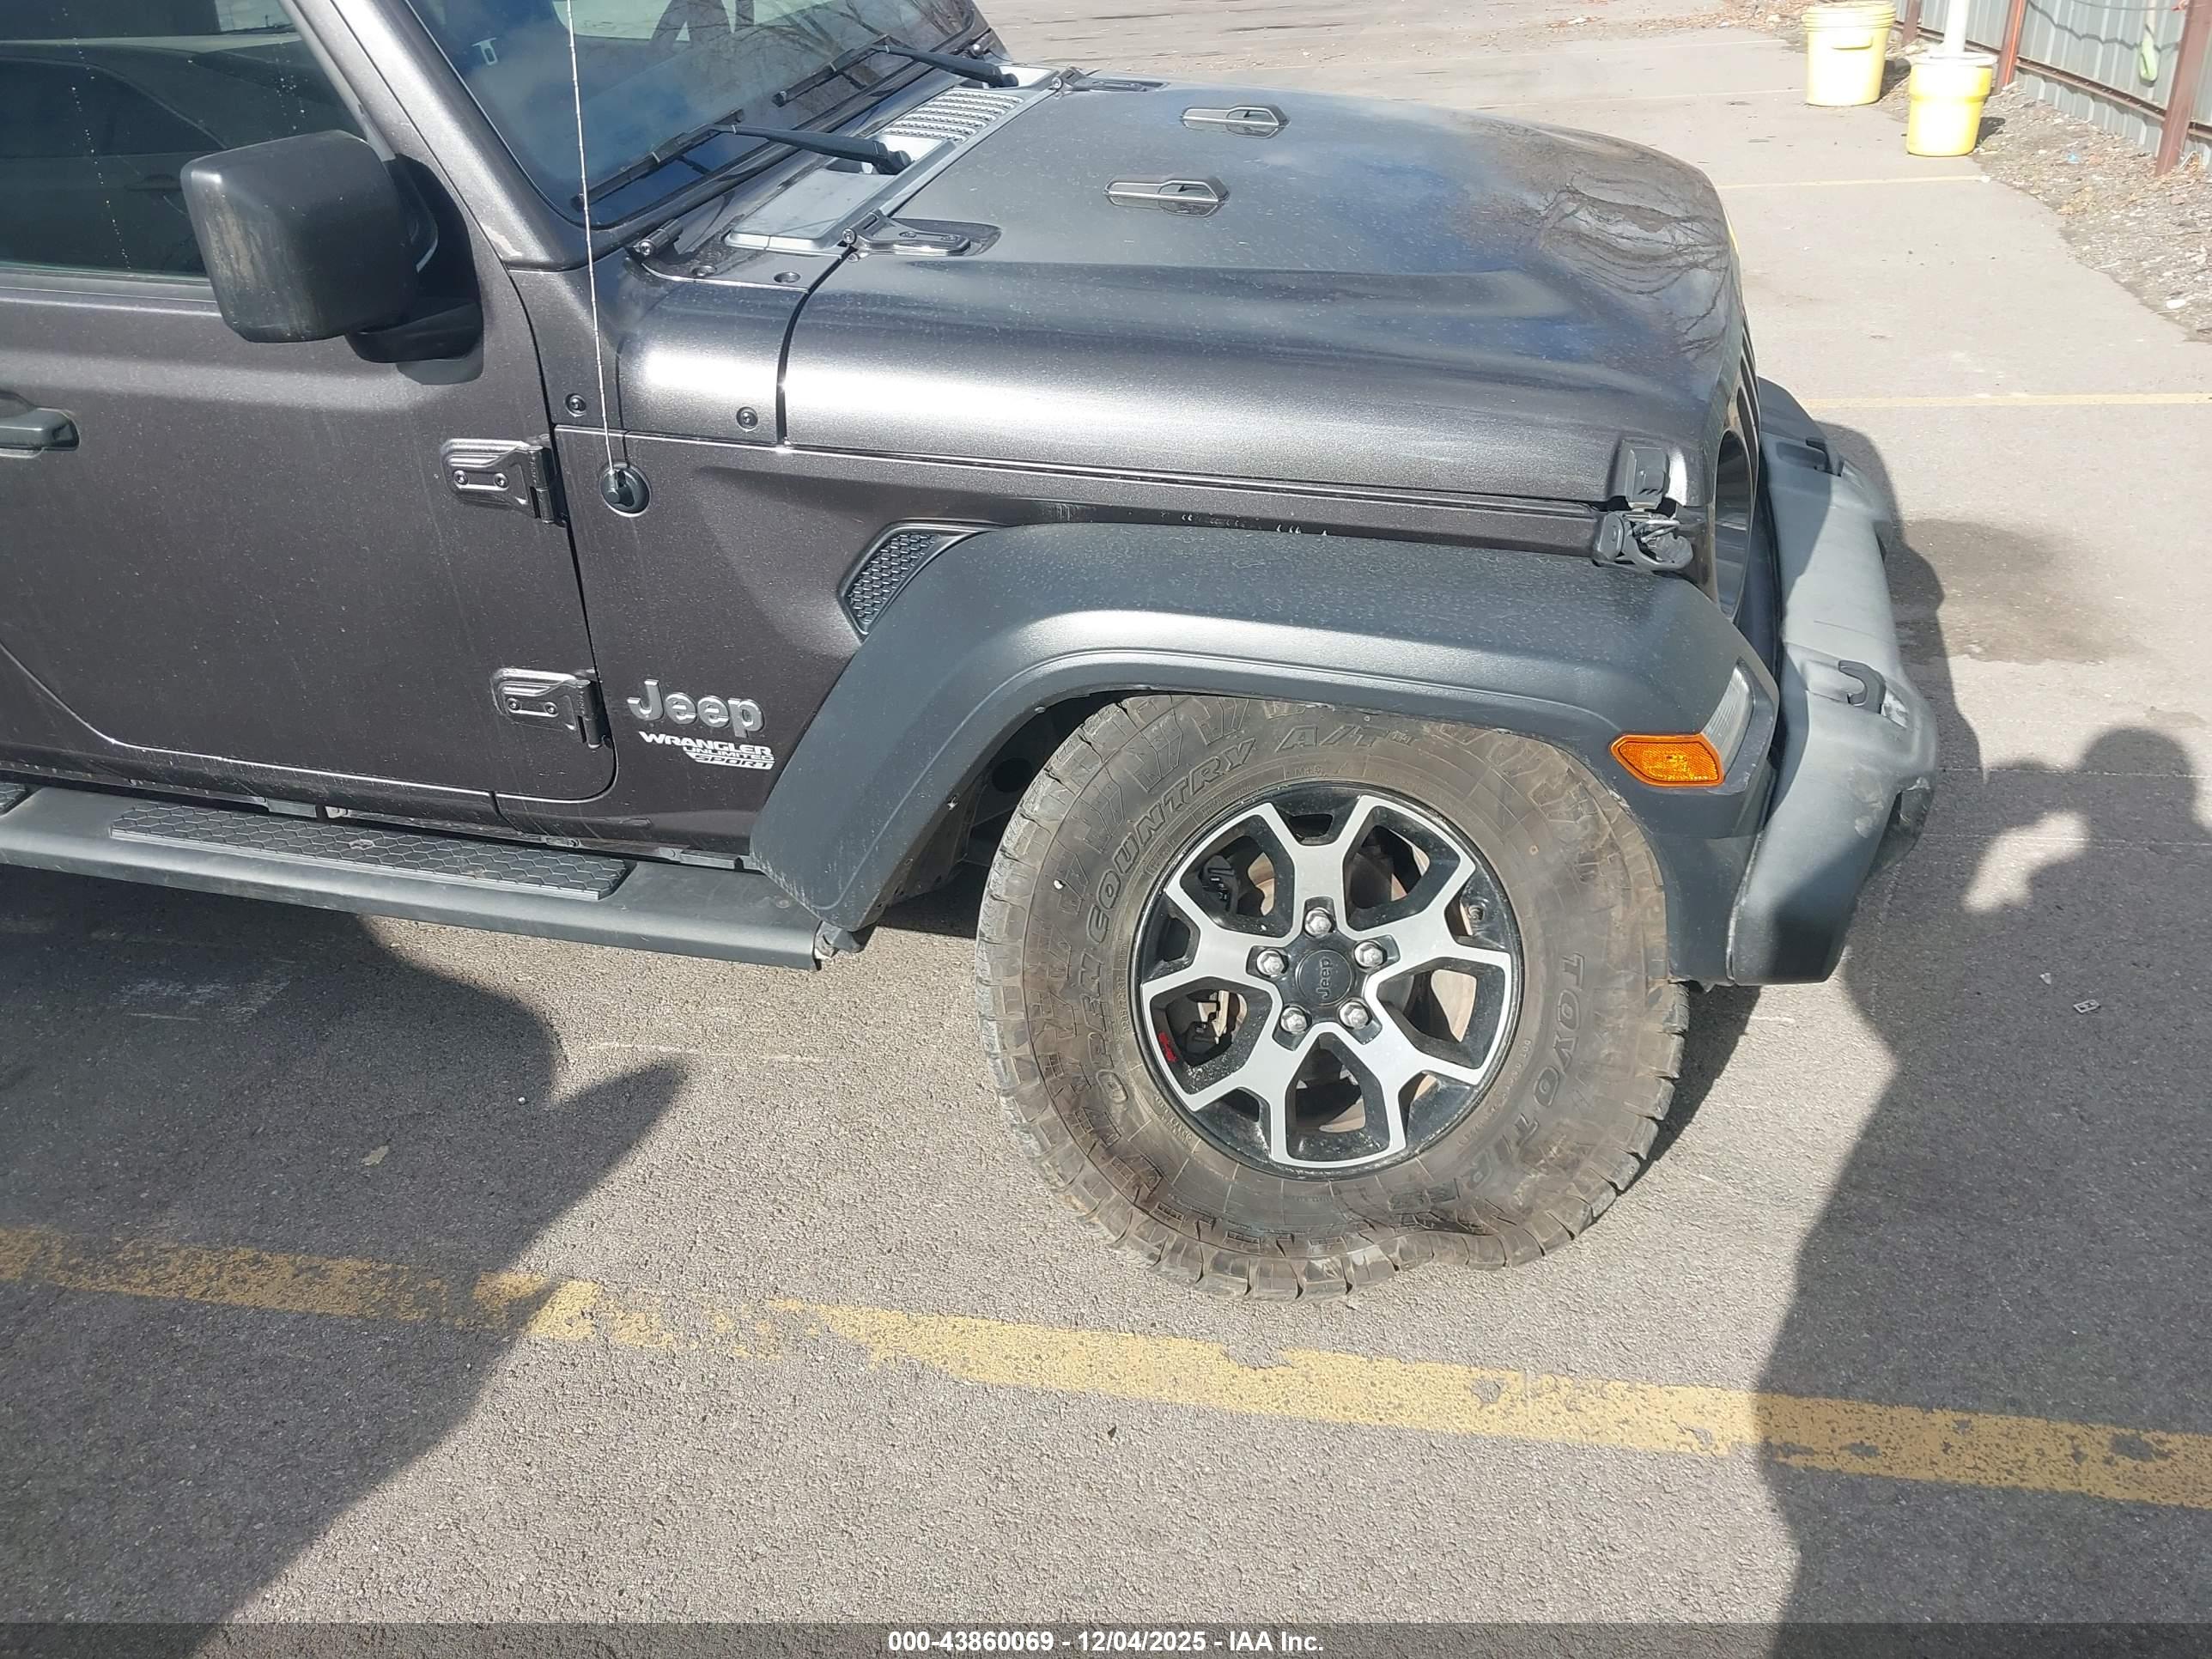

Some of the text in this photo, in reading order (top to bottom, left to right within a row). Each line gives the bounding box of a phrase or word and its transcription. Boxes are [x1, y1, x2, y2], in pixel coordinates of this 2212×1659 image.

[627, 678, 764, 738] Jeep
[638, 731, 773, 757] WRANGLER
[682, 746, 775, 761] UNLIMITED
[1274, 724, 1390, 753] A/T
[691, 753, 774, 769] SPORT
[1086, 738, 1257, 945] COUNTRY
[1316, 957, 1334, 1000] Jeep
[1079, 950, 1128, 1103] OPEN
[1534, 952, 1584, 1106] TOYO
